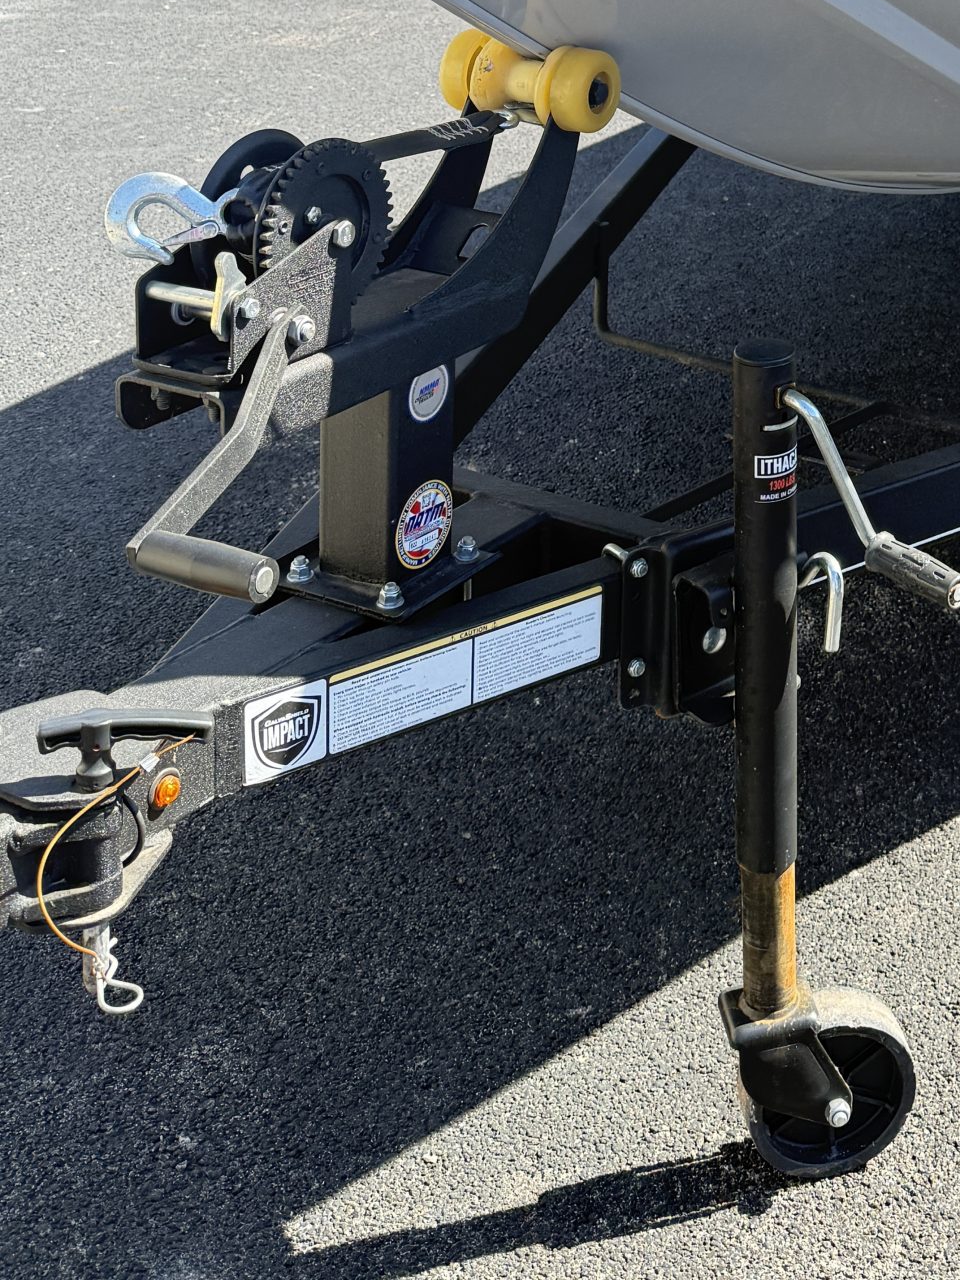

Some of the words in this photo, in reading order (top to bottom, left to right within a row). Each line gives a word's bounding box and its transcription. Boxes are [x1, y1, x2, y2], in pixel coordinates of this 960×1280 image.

[769, 478, 785, 491] 1300
[760, 493, 780, 501] MADE
[780, 490, 787, 498] IN
[460, 625, 488, 639] CAUTION
[263, 714, 311, 751] IMPACT
